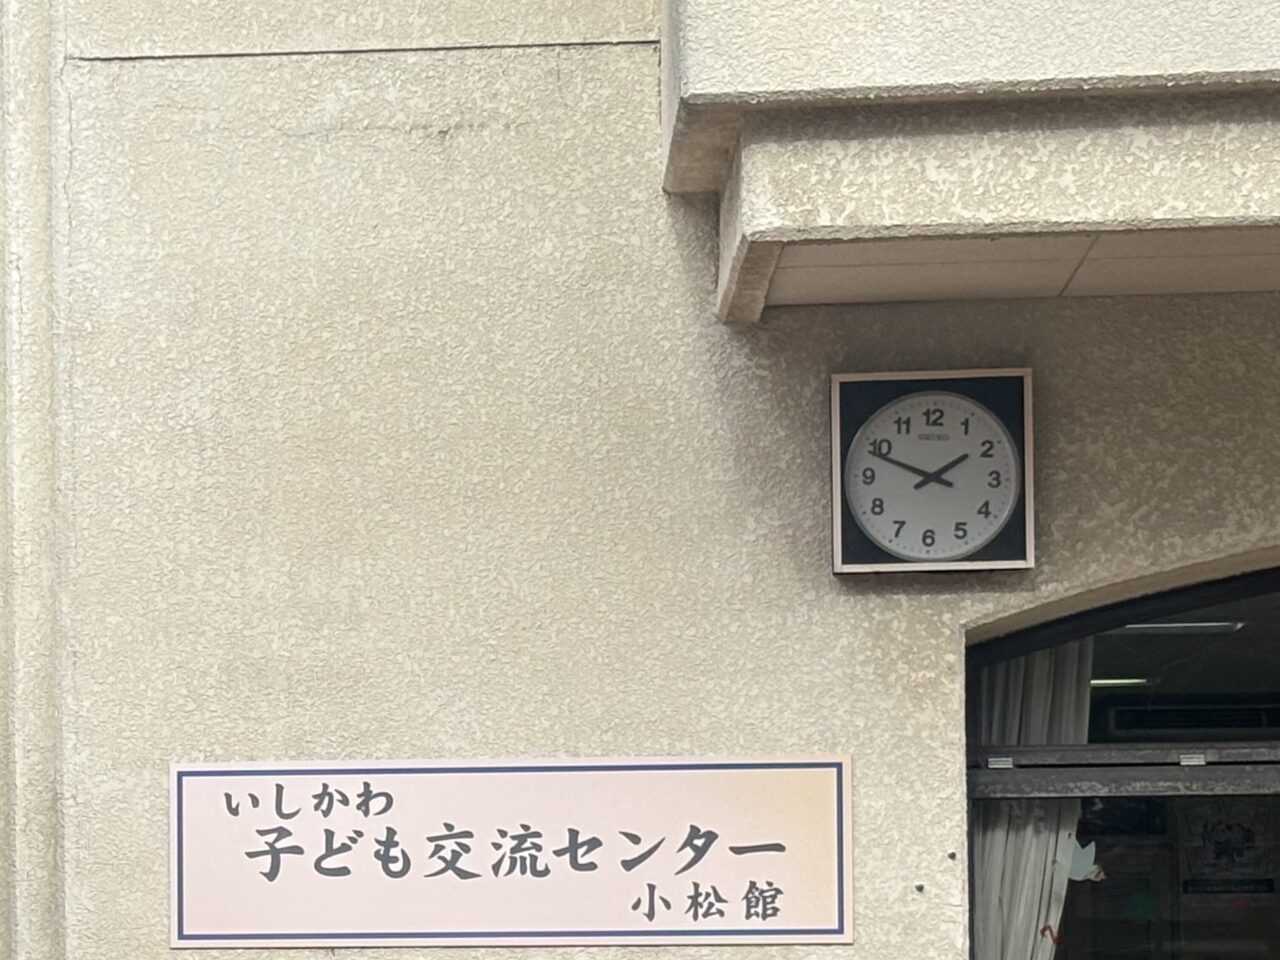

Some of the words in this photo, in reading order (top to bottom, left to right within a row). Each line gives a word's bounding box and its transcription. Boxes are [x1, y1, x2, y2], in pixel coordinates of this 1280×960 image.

[894, 417, 911, 434] 11
[922, 408, 944, 426] 12
[960, 418, 970, 435] 1
[869, 439, 892, 456] 10
[980, 440, 994, 458] 2
[862, 467, 876, 485] 9
[987, 470, 1001, 488] 3
[871, 498, 885, 515] 8
[977, 501, 991, 518] 4
[892, 520, 906, 538] 7
[921, 529, 936, 547] 6
[954, 522, 968, 539] 5
[224, 781, 395, 819] いしかわ
[243, 822, 788, 883] 子ども交流センター
[631, 880, 785, 922] 小松館
